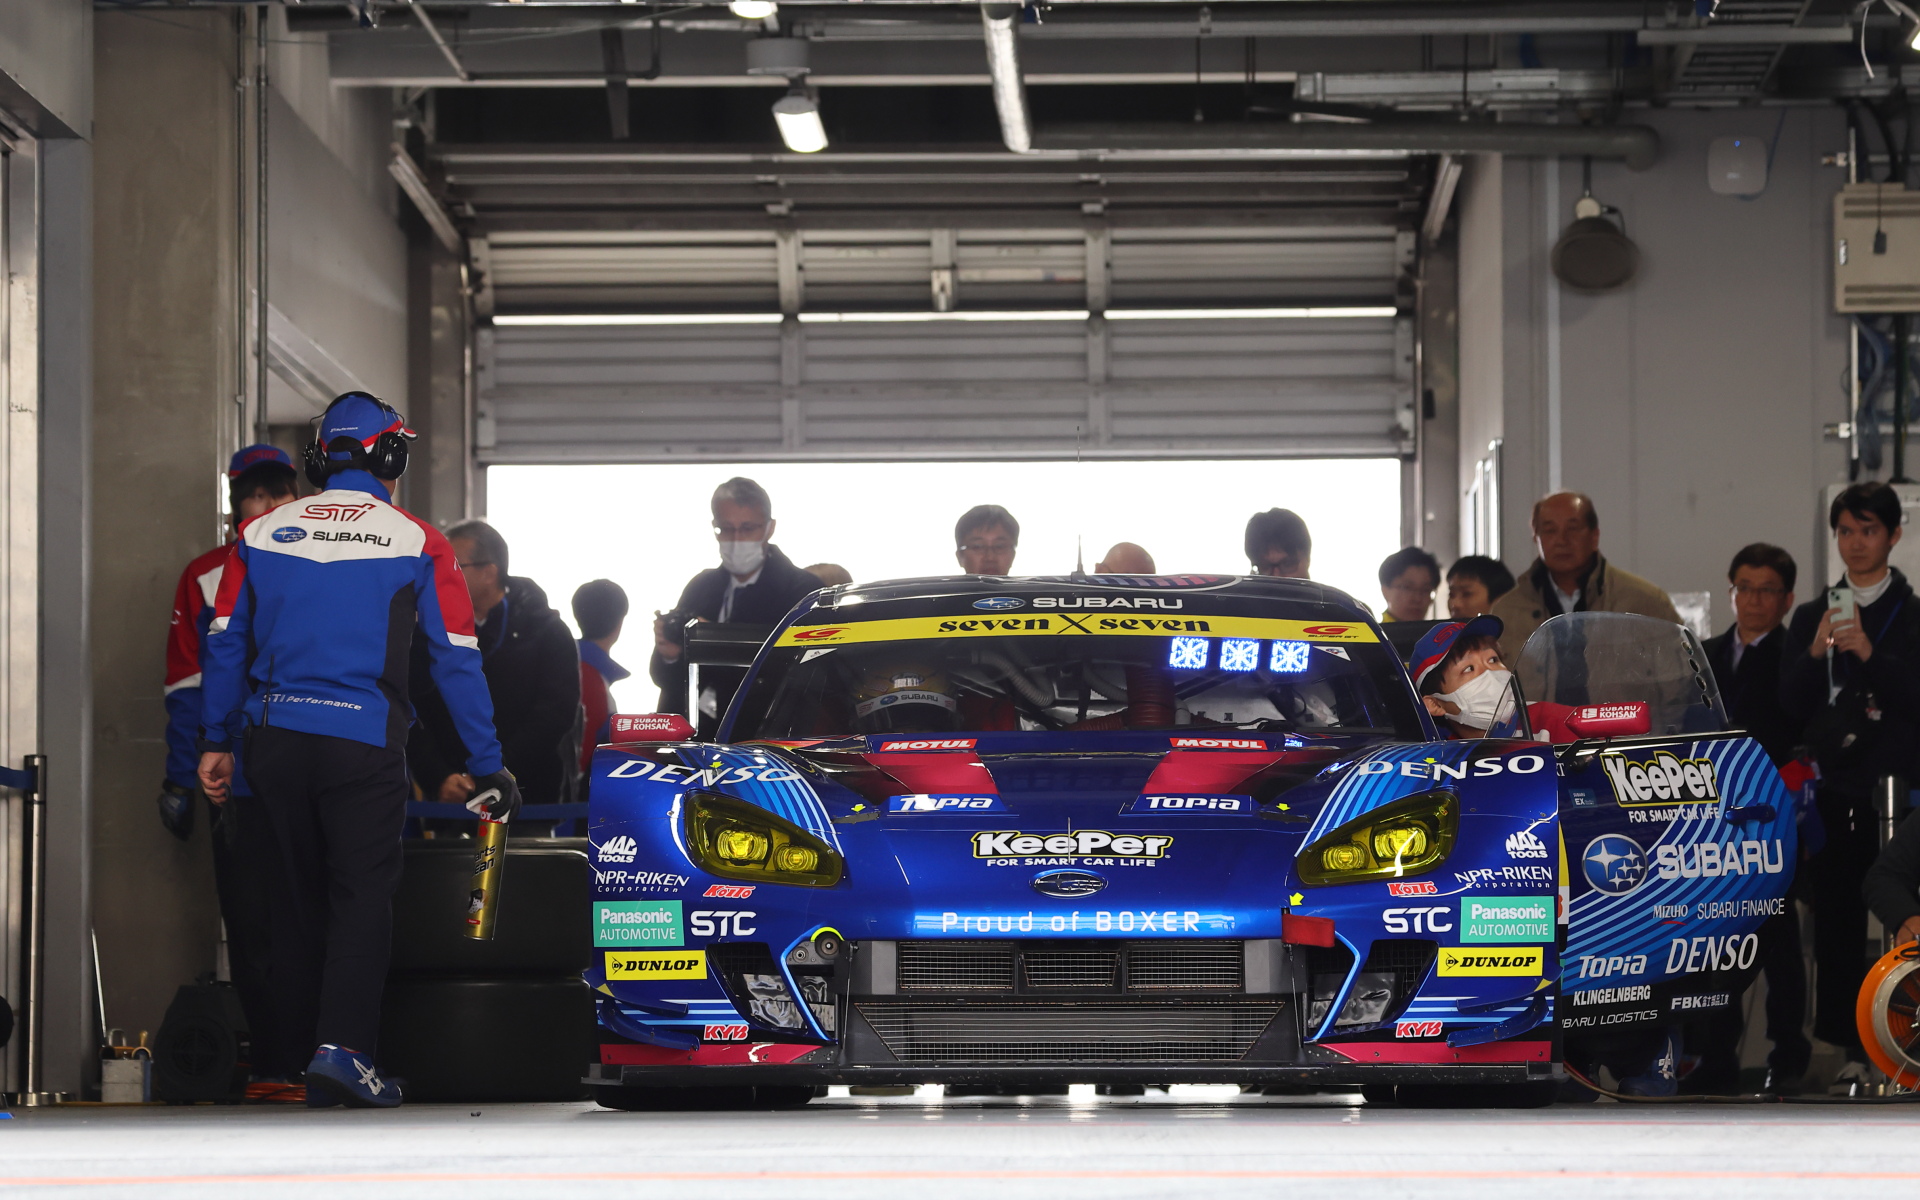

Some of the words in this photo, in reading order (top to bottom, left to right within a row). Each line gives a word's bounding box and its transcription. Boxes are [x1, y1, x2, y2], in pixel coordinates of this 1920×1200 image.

[312, 531, 391, 547] SUBARU
[1032, 597, 1184, 610] SUBARU
[938, 616, 1050, 633] seven
[1057, 614, 1093, 634] X
[1099, 617, 1211, 633] seven
[286, 695, 362, 711] Performance
[900, 693, 938, 702] SUBARU
[632, 723, 669, 731] KOHSAN
[884, 740, 971, 751] MOTUL
[1176, 738, 1263, 749] MOTUL
[606, 759, 802, 787] DENSO
[1358, 755, 1545, 781] DENSO
[1604, 755, 1717, 803] KeePer
[1628, 810, 1648, 824] FOR
[1650, 809, 1680, 822] SMART
[1681, 807, 1698, 821] CAR
[1700, 806, 1720, 819] LIFE
[598, 835, 638, 856] MAC
[976, 831, 1169, 856] KeePer
[1505, 831, 1546, 851] MAC
[474, 844, 497, 863] arts
[598, 855, 635, 864] TOOLS
[1507, 850, 1548, 859] TOOLS
[1656, 838, 1783, 881] SUBARU
[473, 857, 495, 875] ean
[986, 859, 1018, 867] FOR
[1024, 858, 1076, 866] SMART
[1083, 858, 1114, 866] CAR
[1120, 859, 1156, 867] LIFE
[595, 871, 690, 887] NPR-RIKEN
[1454, 866, 1553, 884] NPR-RIKEN
[597, 885, 678, 894] Corporation
[1466, 881, 1551, 890] Corporation
[600, 908, 673, 924] Panasonic
[1471, 903, 1547, 920] Panasonic
[1697, 902, 1739, 920] SUBARU
[1741, 898, 1785, 917] FINANCE
[690, 910, 757, 937] STC
[942, 911, 1034, 933] Proud
[1051, 911, 1079, 932] of
[1096, 911, 1200, 932] BOXER
[1382, 906, 1453, 933] STC
[599, 927, 676, 940] AUTOMOTIVE
[1469, 924, 1548, 936] AUTOMOTIVE
[1459, 956, 1537, 967] DUNLOP
[1664, 933, 1759, 974] DENSO
[624, 960, 699, 972] DUNLOP
[1573, 984, 1651, 1006] KLINGELNBERG
[1562, 1016, 1596, 1029] BARU
[1600, 1009, 1658, 1025] LOGISTICS
[703, 1025, 750, 1041] KYB
[1395, 1020, 1443, 1038] KYB
